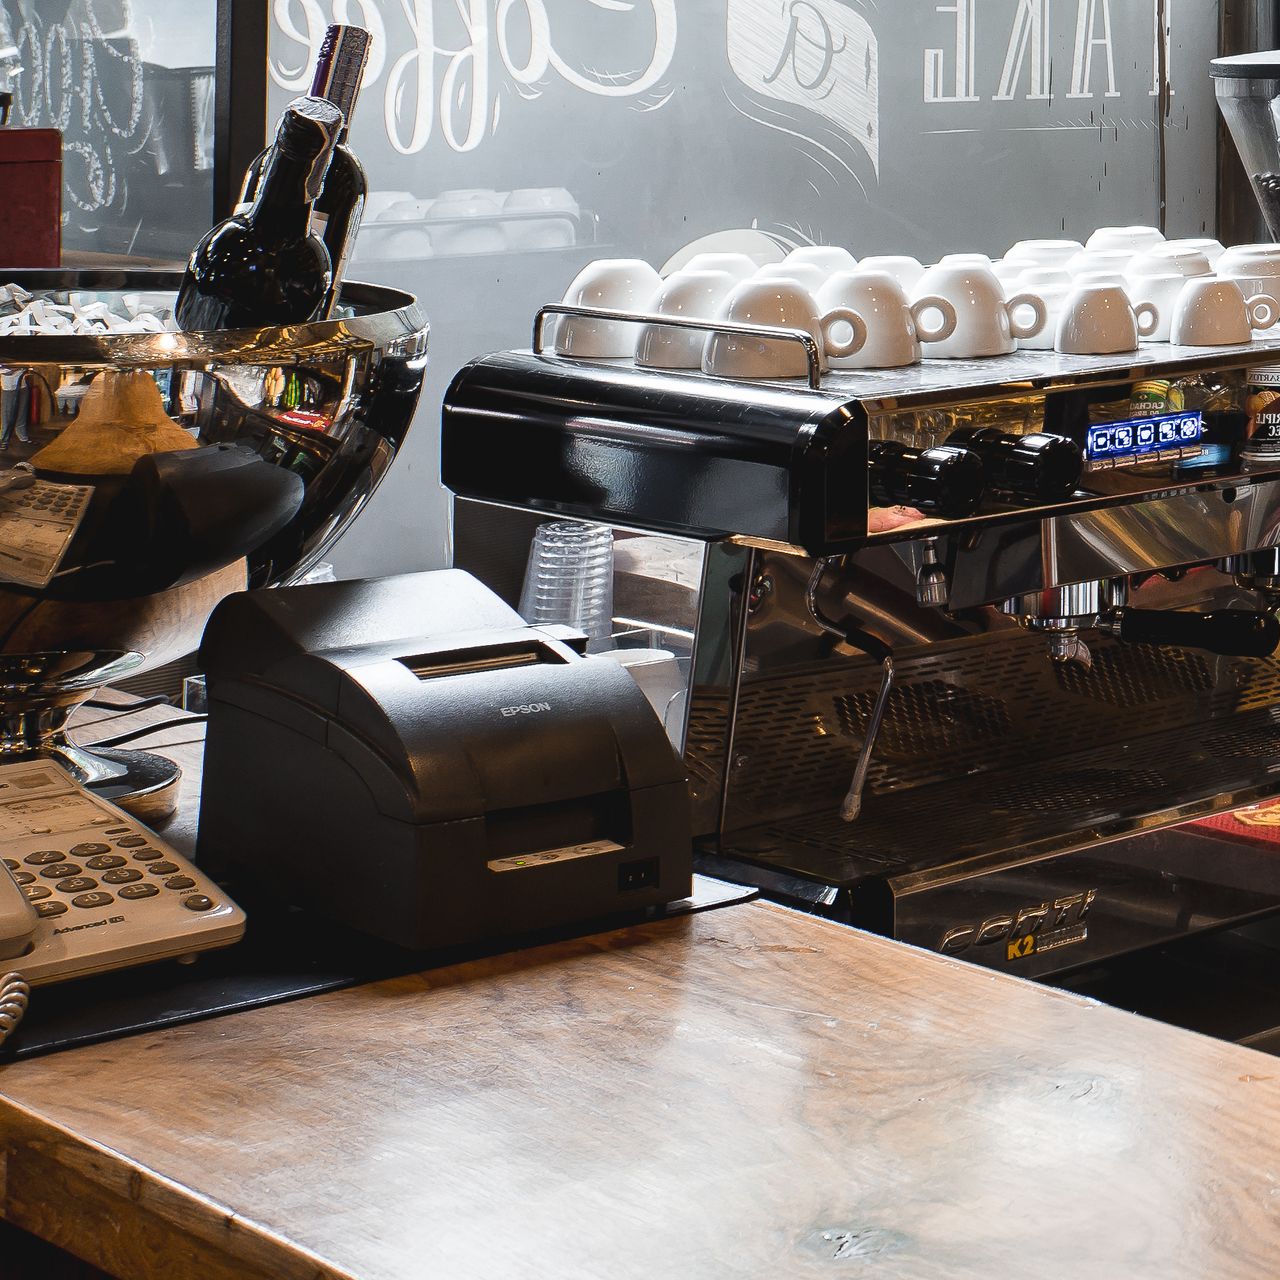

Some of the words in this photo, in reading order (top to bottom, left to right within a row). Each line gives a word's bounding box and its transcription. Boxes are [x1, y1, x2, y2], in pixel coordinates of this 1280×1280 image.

[500, 700, 551, 718] EPSON
[53, 918, 107, 936] Advanced
[1006, 935, 1034, 960] K2
